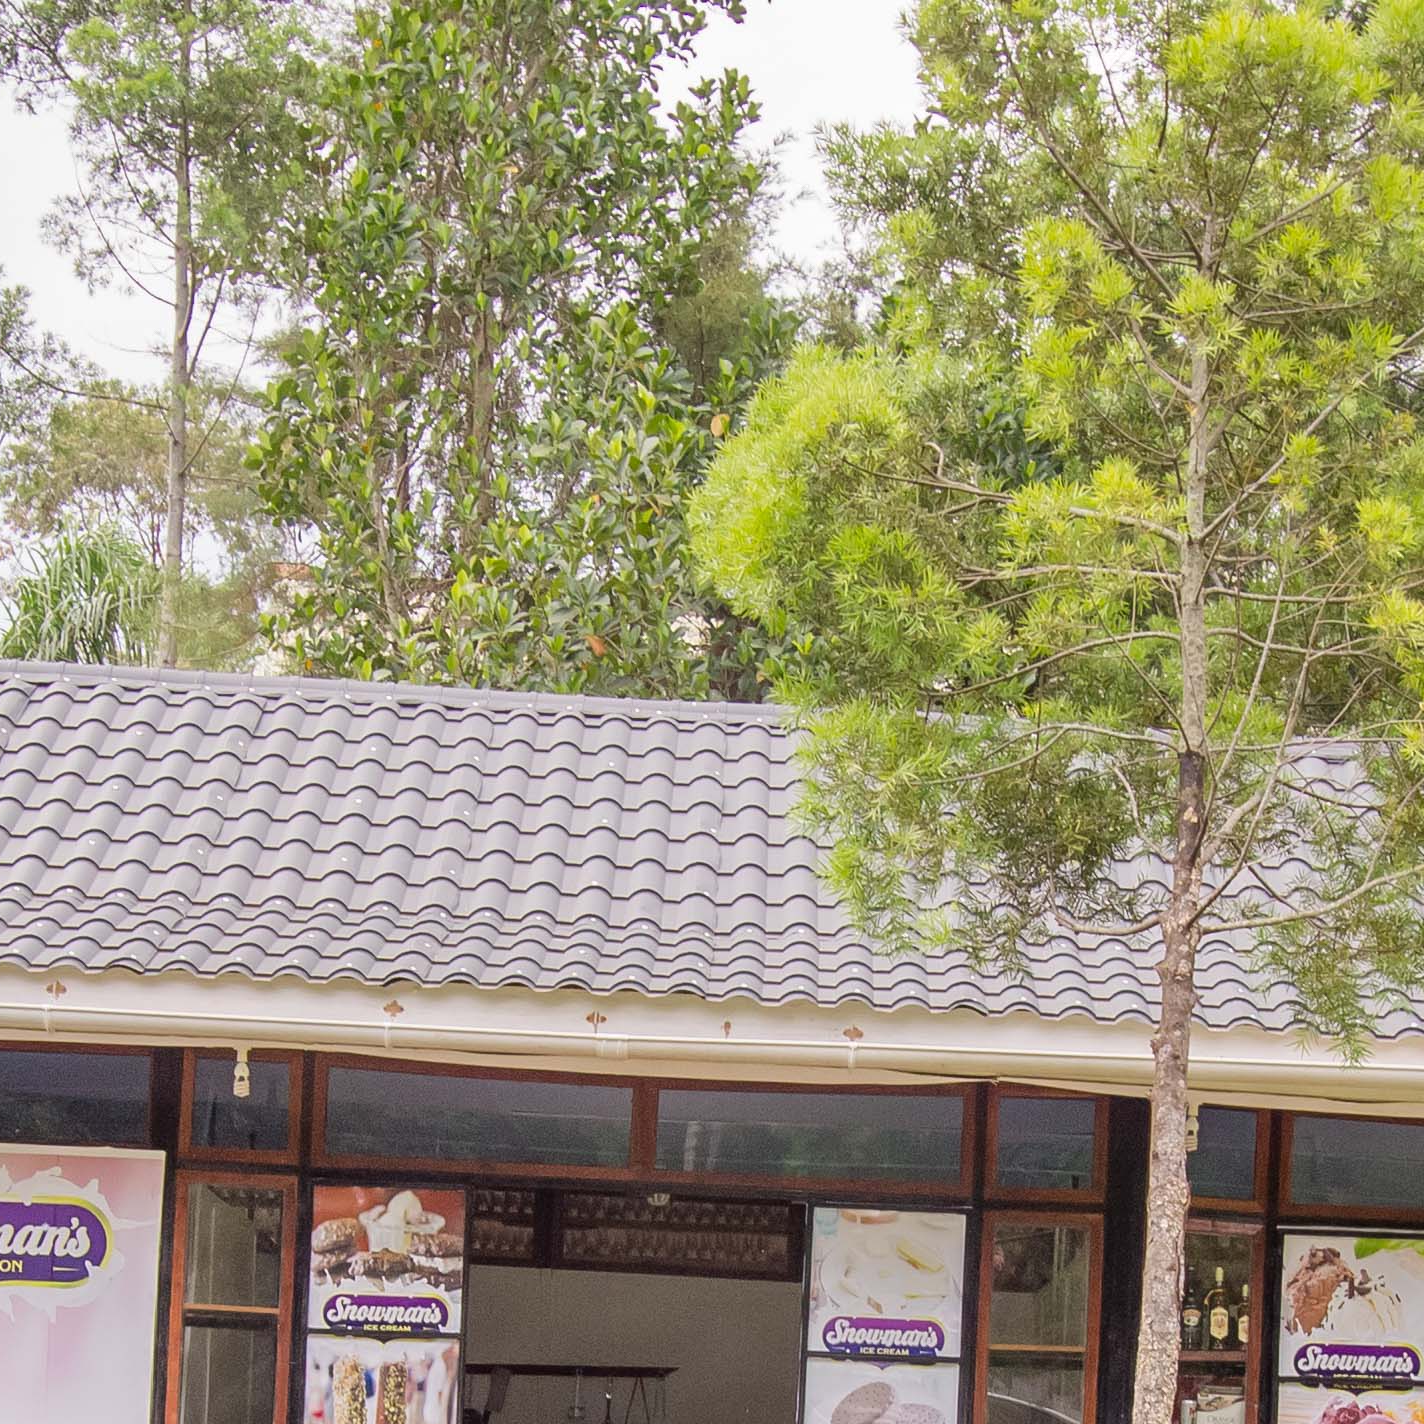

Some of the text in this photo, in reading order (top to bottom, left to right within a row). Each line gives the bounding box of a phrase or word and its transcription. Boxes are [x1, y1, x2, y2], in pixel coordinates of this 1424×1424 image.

[327, 1296, 442, 1324] Snowman's
[380, 1324, 412, 1332] CREAM
[826, 1318, 938, 1348] Snowman's
[860, 1346, 910, 1356] ICE CREAM
[1297, 1345, 1414, 1373] Snowman's
